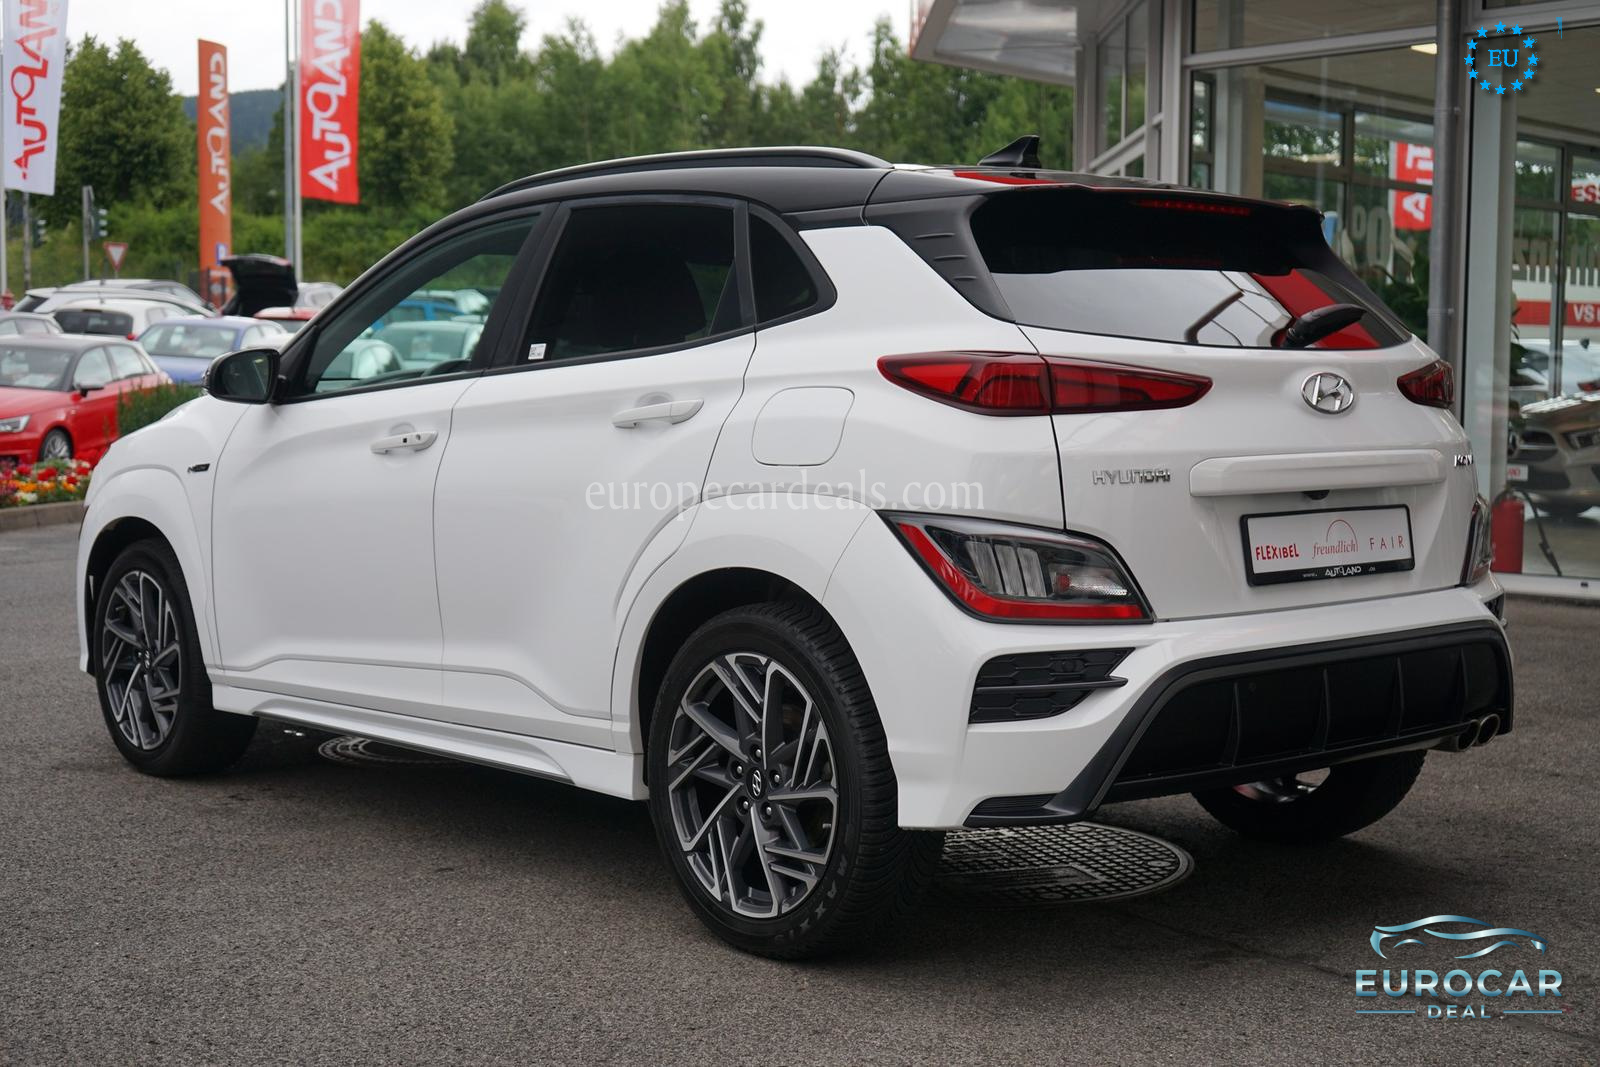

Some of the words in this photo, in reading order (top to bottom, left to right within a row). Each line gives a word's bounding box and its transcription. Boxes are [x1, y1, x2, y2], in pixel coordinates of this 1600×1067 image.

[306, 0, 350, 192] AUTOLAND
[1092, 468, 1171, 485] HYUNDAI
[1255, 543, 1299, 561] FLEXIBEL
[1312, 540, 1357, 559] freundlich
[1369, 535, 1405, 551] FAIR
[1325, 565, 1362, 577] AUTOLAND
